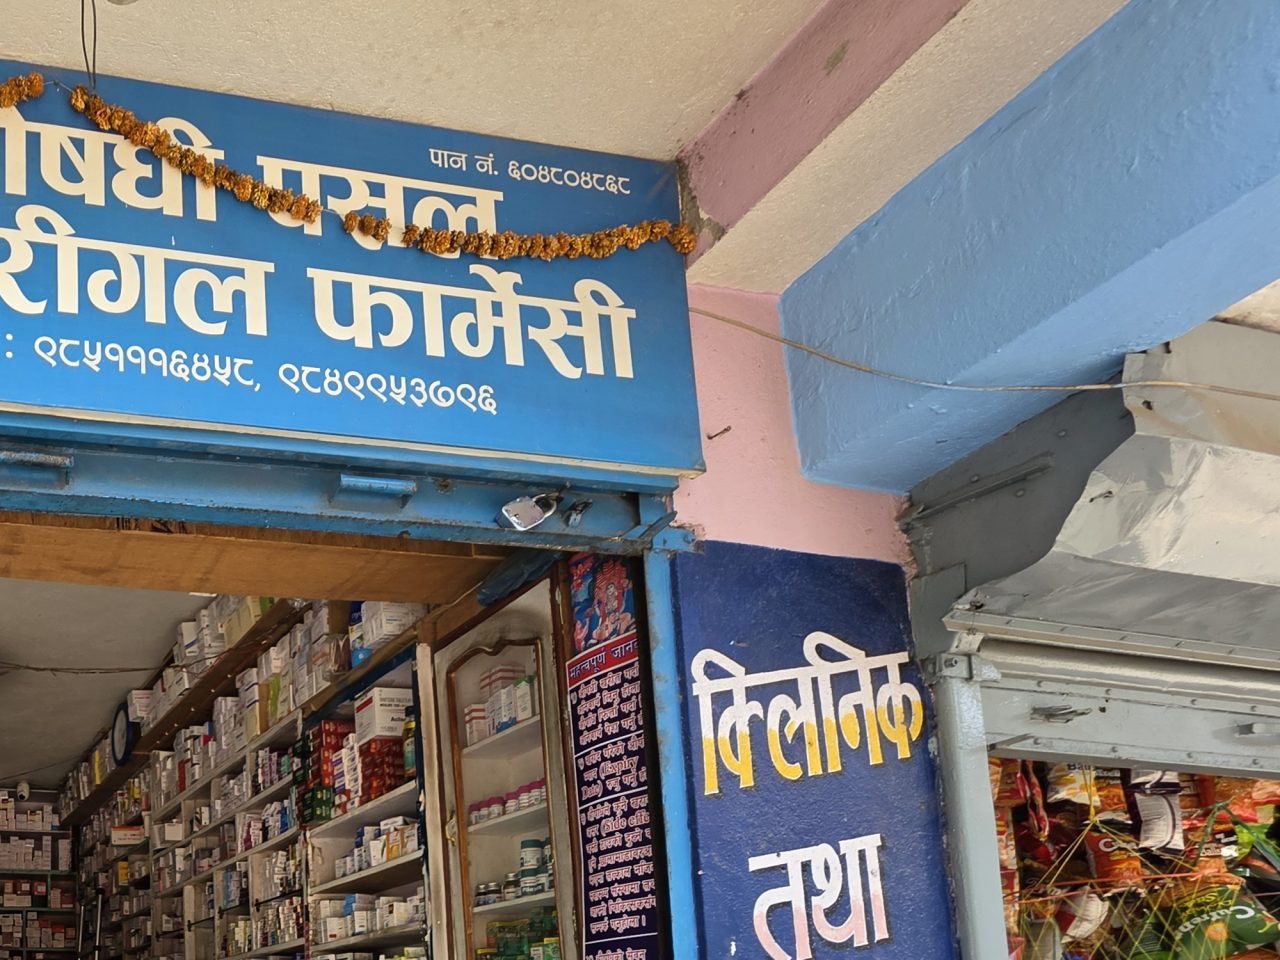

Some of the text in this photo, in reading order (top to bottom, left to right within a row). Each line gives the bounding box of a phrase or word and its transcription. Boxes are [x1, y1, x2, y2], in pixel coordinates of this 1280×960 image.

[428, 148, 468, 171] पान
[508, 160, 631, 195] ६०४८०४८६८
[306, 264, 637, 380] फार्मेसी
[599, 756, 639, 780] (Expiry
[600, 815, 627, 837] (Side
